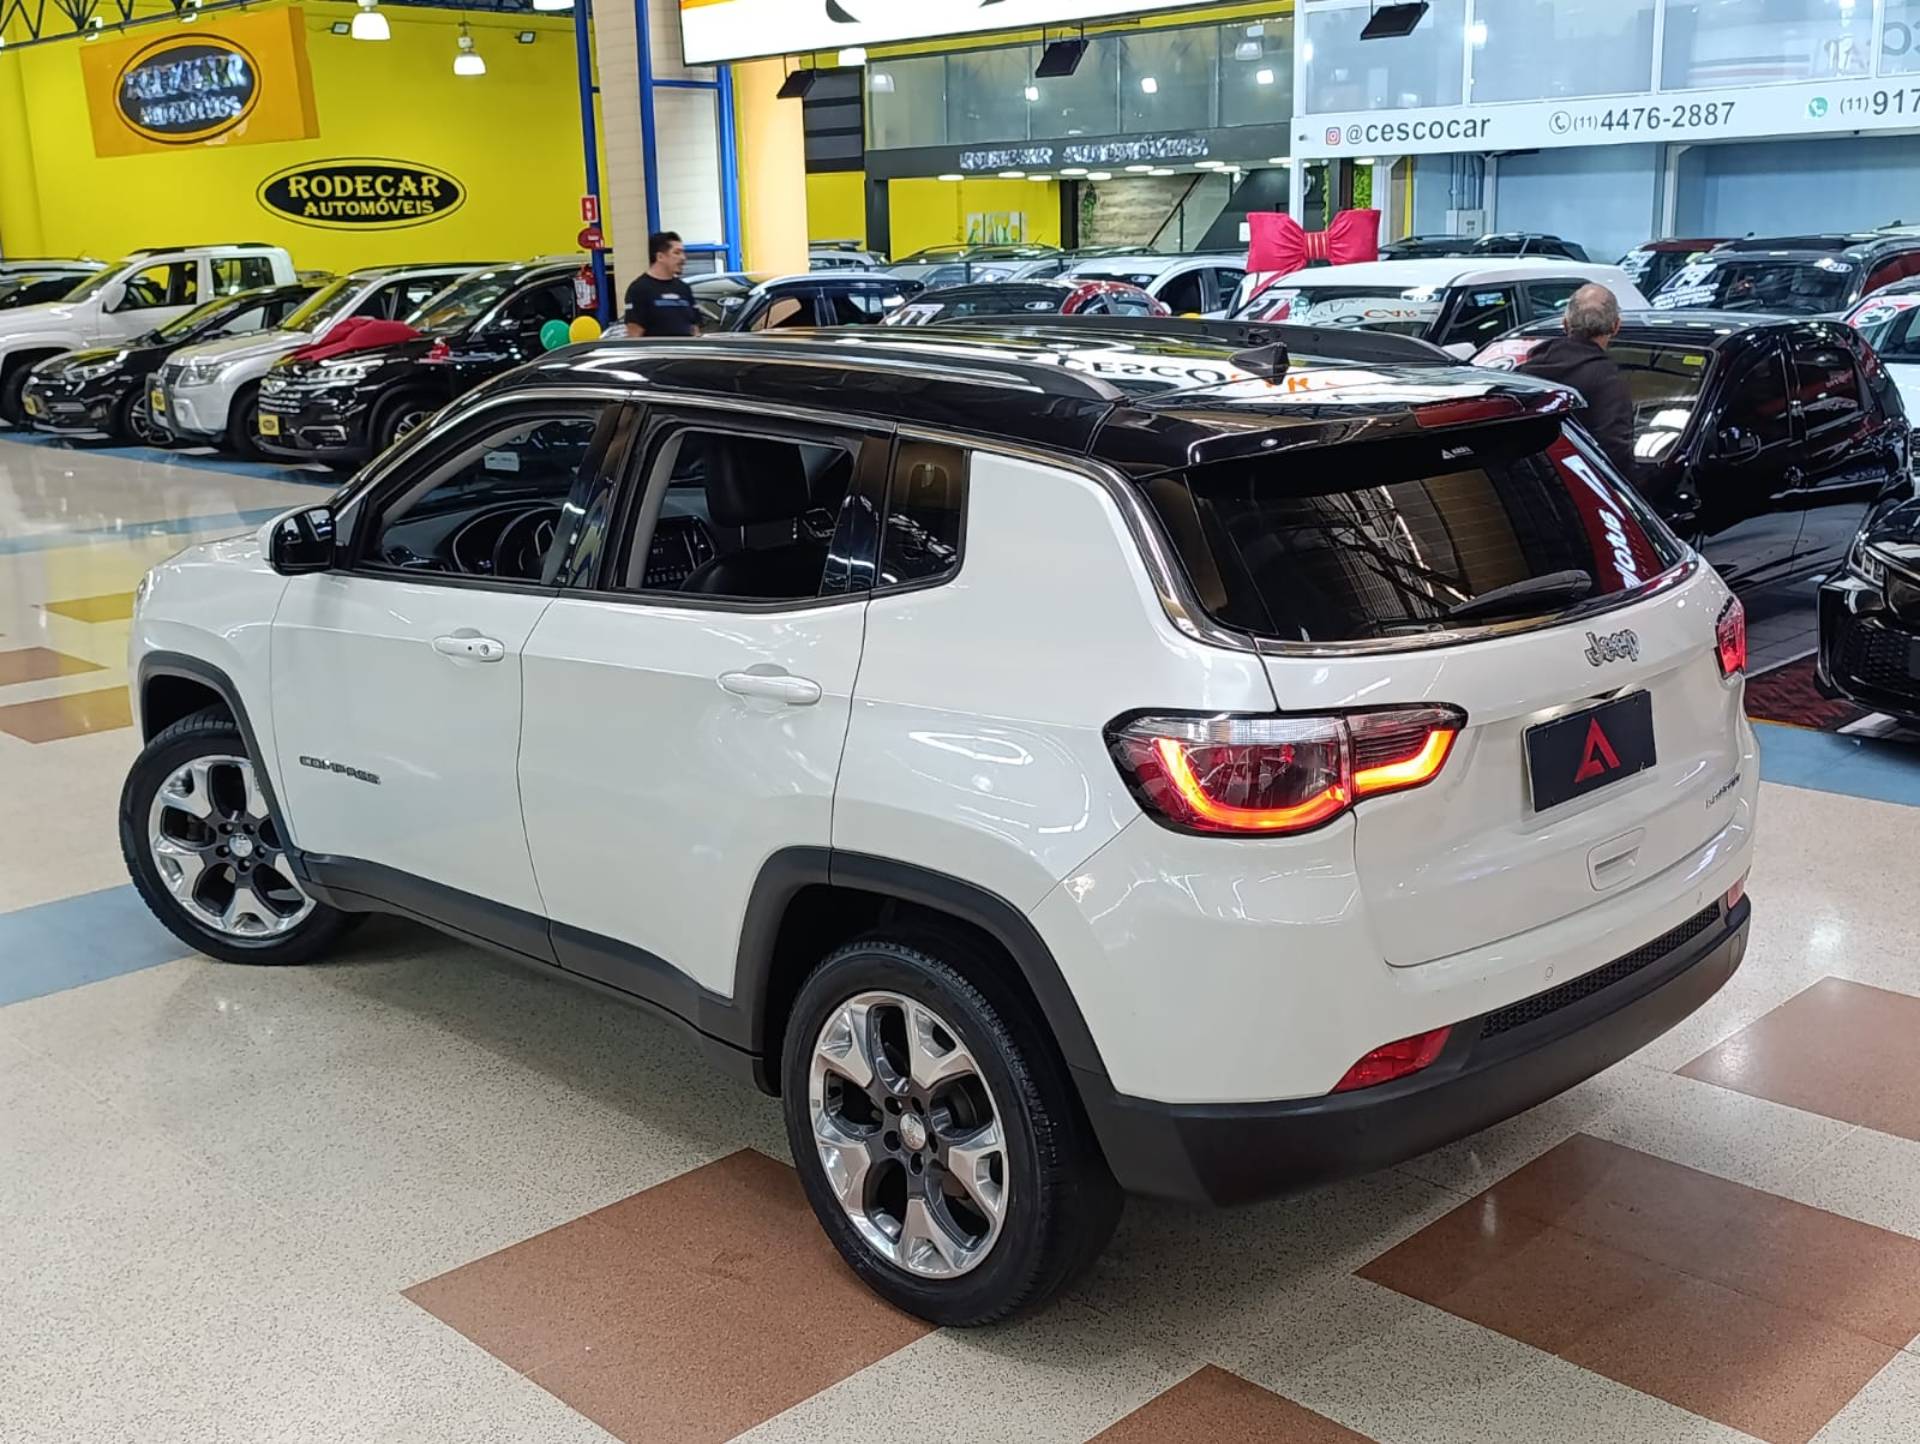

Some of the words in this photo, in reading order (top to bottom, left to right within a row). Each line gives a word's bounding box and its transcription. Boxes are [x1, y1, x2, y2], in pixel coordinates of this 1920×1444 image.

[1345, 118, 1491, 145] @cescocar
[288, 175, 442, 199] RODECAR
[303, 196, 435, 217] AUTOMÓVEIS
[1584, 628, 1641, 668] Jeep
[299, 755, 381, 785] COMPASS
